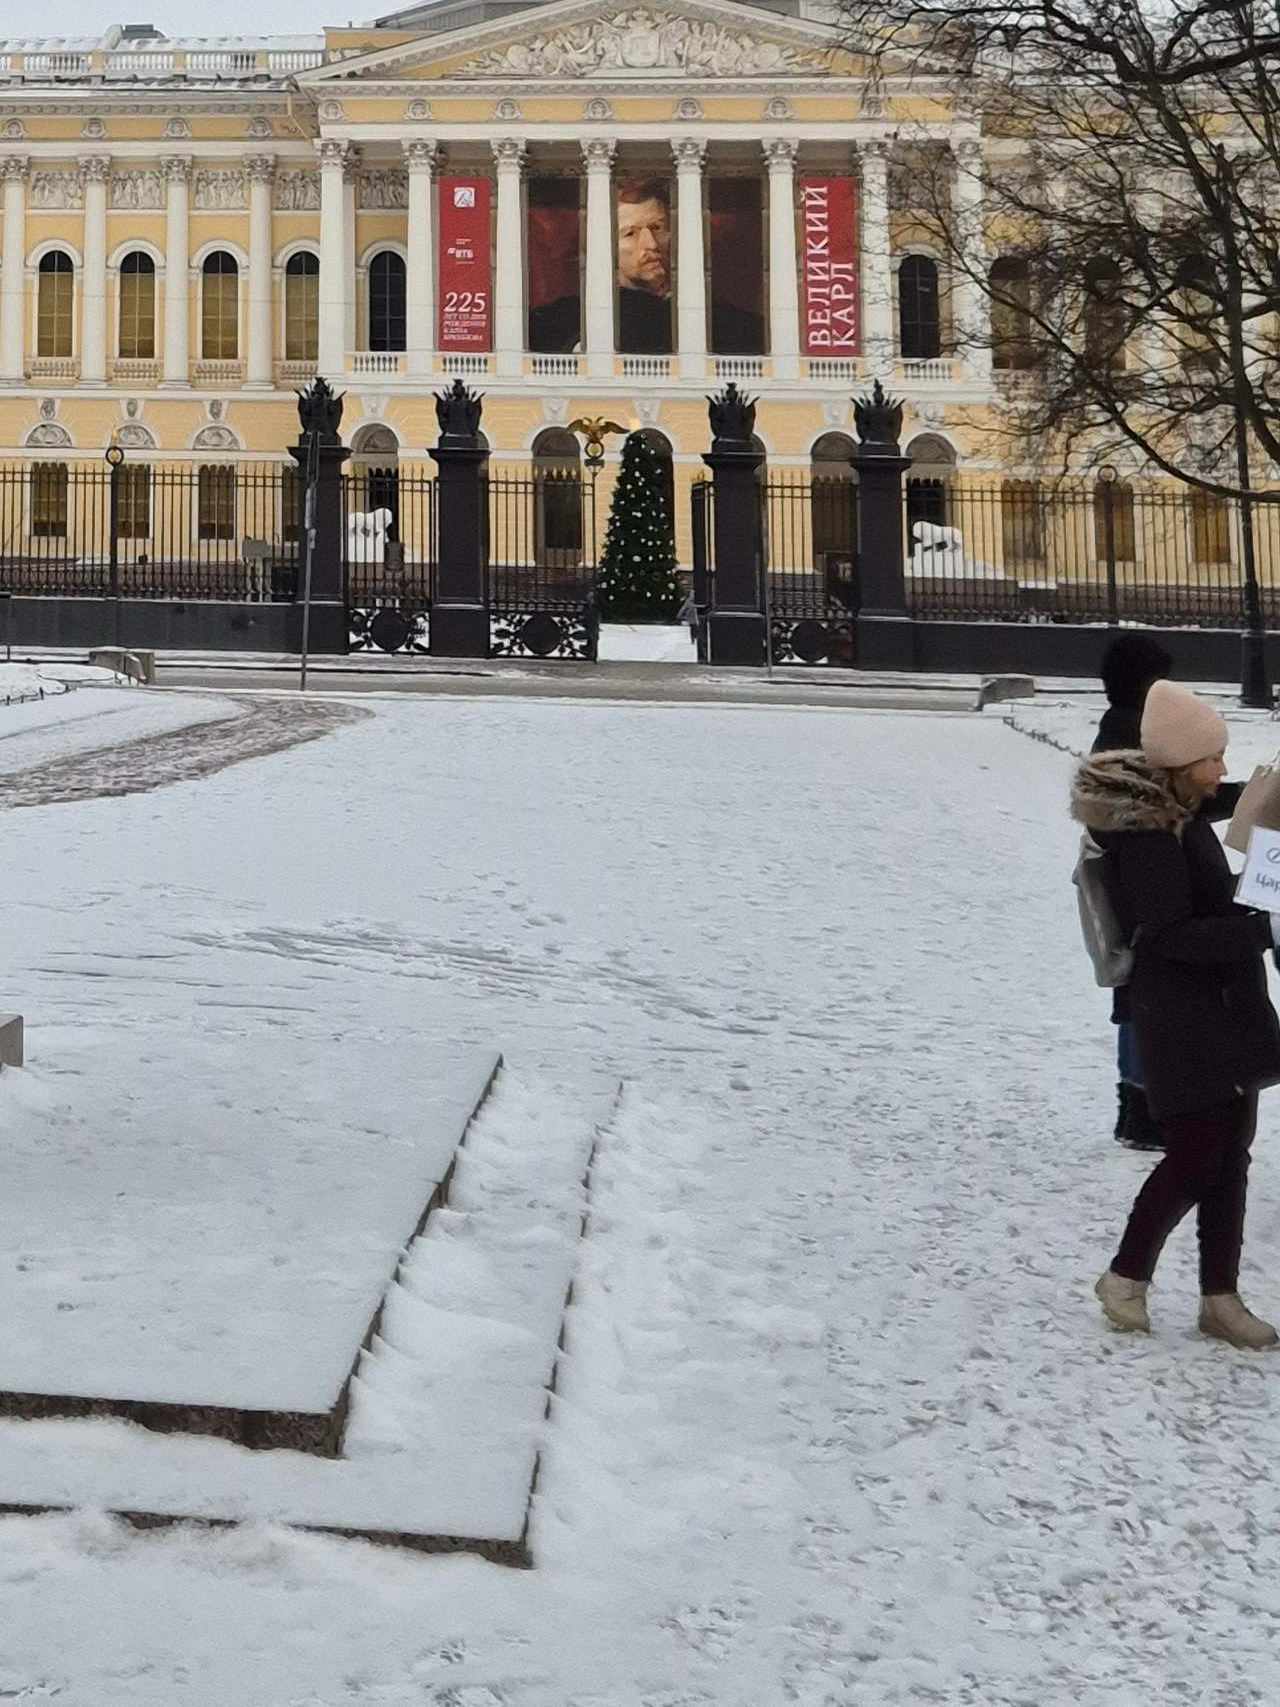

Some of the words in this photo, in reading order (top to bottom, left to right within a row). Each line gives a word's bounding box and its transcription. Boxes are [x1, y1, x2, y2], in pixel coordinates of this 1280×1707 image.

[443, 291, 487, 313] 225
[800, 186, 831, 348] ВЕЛИКИЙ
[830, 262, 856, 348] КАРЛ
